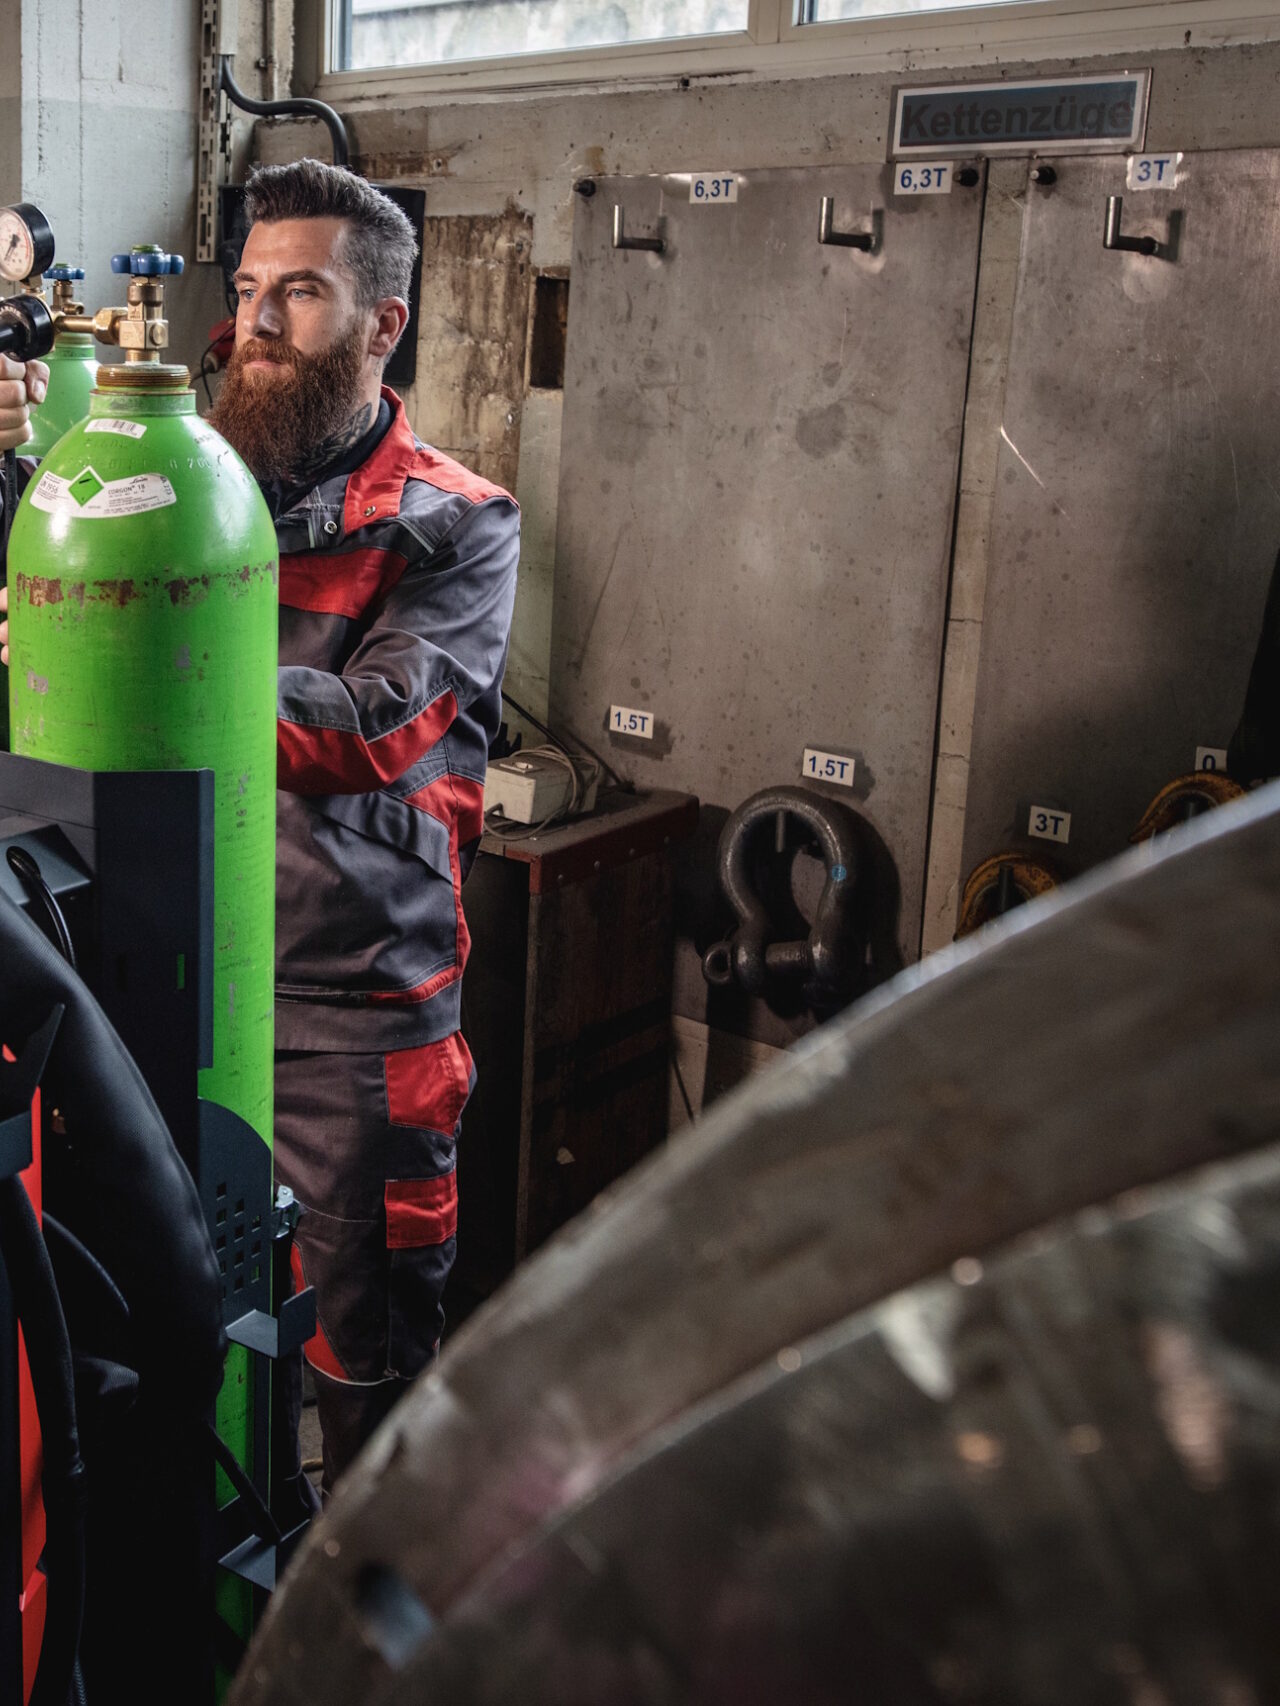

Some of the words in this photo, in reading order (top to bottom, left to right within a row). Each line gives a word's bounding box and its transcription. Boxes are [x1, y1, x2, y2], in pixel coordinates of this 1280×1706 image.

[902, 97, 1131, 138] Kettenzüge
[900, 167, 948, 191] 6,3T
[1137, 160, 1170, 182] 3T
[694, 178, 734, 201] 6,3T
[614, 711, 649, 733] 1,5T
[808, 755, 849, 779] 1,5T
[1035, 813, 1064, 836] 3T
